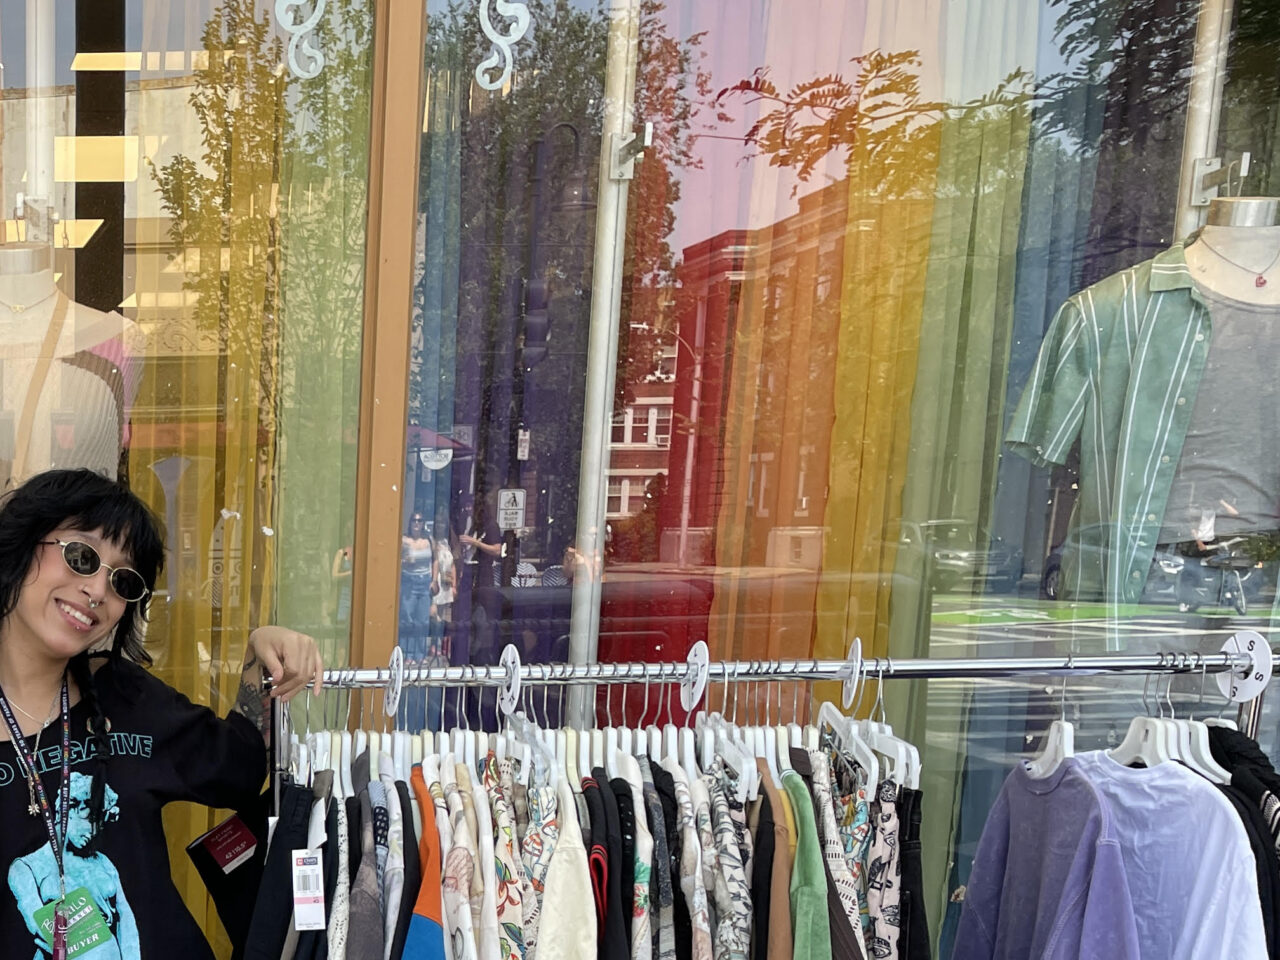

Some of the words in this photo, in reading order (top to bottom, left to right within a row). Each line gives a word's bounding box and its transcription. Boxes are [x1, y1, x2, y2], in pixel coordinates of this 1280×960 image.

[1247, 640, 1256, 652] S
[1254, 672, 1264, 682] S
[15, 732, 153, 779] NEGATIVE
[67, 932, 100, 955] BUYER
